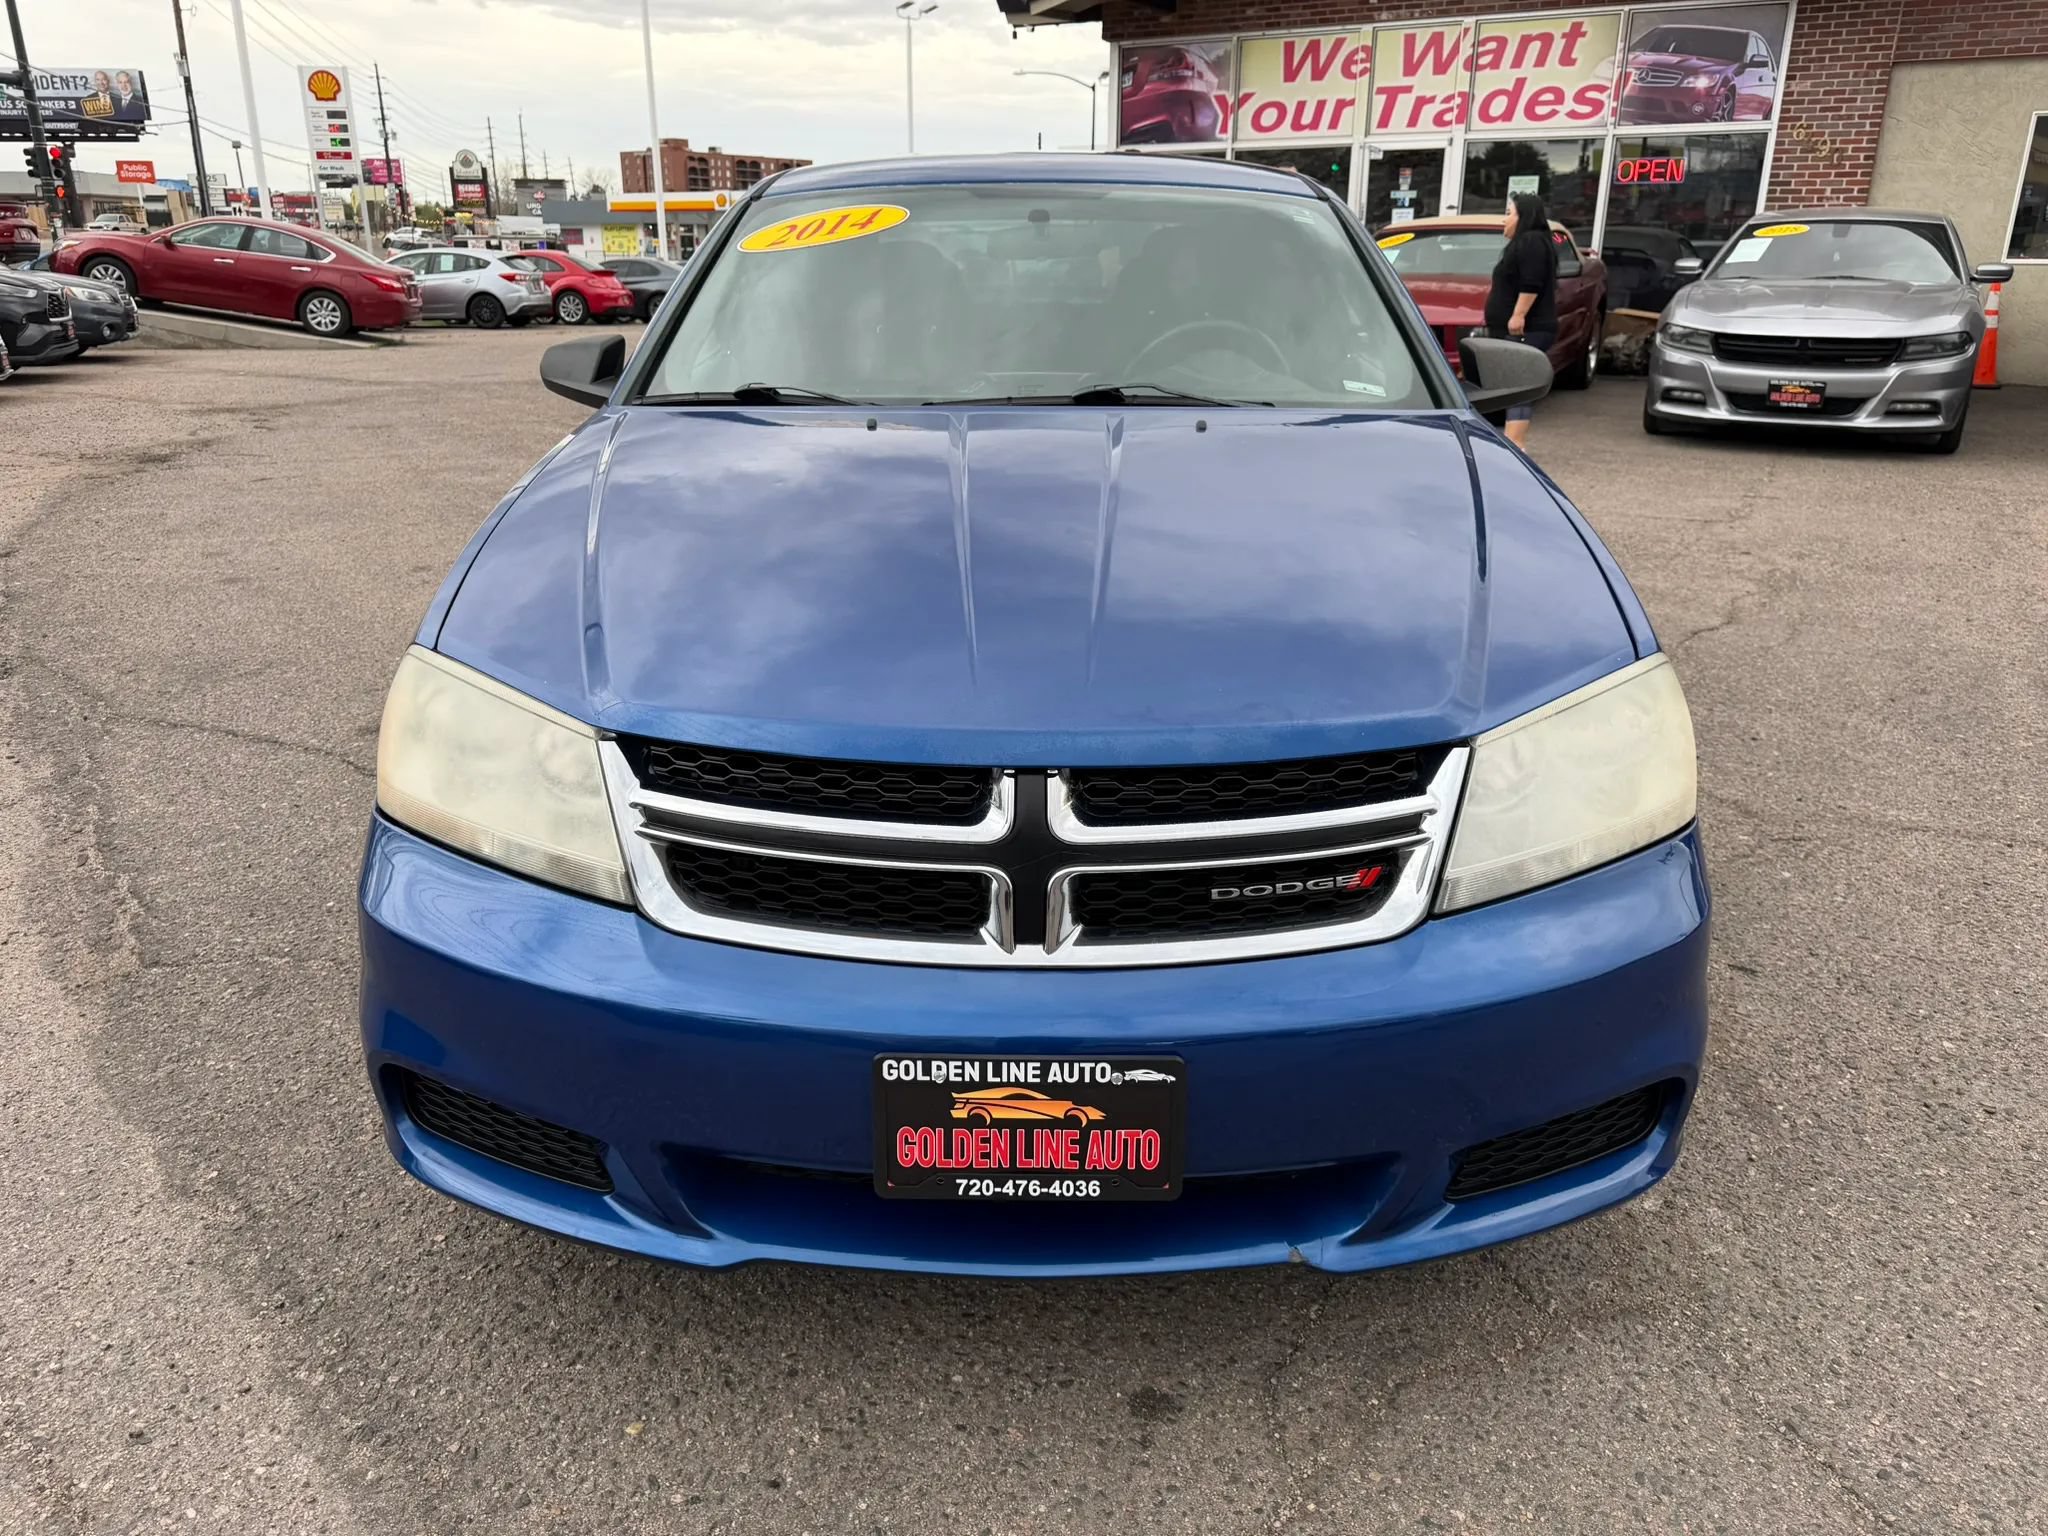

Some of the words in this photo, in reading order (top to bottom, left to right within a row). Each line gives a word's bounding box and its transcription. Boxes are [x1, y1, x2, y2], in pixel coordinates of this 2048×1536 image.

[1282, 35, 1371, 82] We
[1402, 21, 1589, 76] Want
[1213, 92, 1353, 135] Your
[1374, 72, 1637, 129] Trades!
[120, 170, 152, 179] Storage
[1617, 159, 1685, 183] OPEN
[765, 208, 883, 248] 2014
[1210, 873, 1361, 900] DODGE
[882, 1059, 980, 1084] GOLDEN
[988, 1061, 1041, 1083] LINE
[1048, 1062, 1112, 1084] AUTO
[896, 1126, 1010, 1169] GOLDEN
[1016, 1129, 1080, 1169] LINE
[1086, 1129, 1161, 1171] AUTO
[955, 1178, 1101, 1198] 720-476-4036
